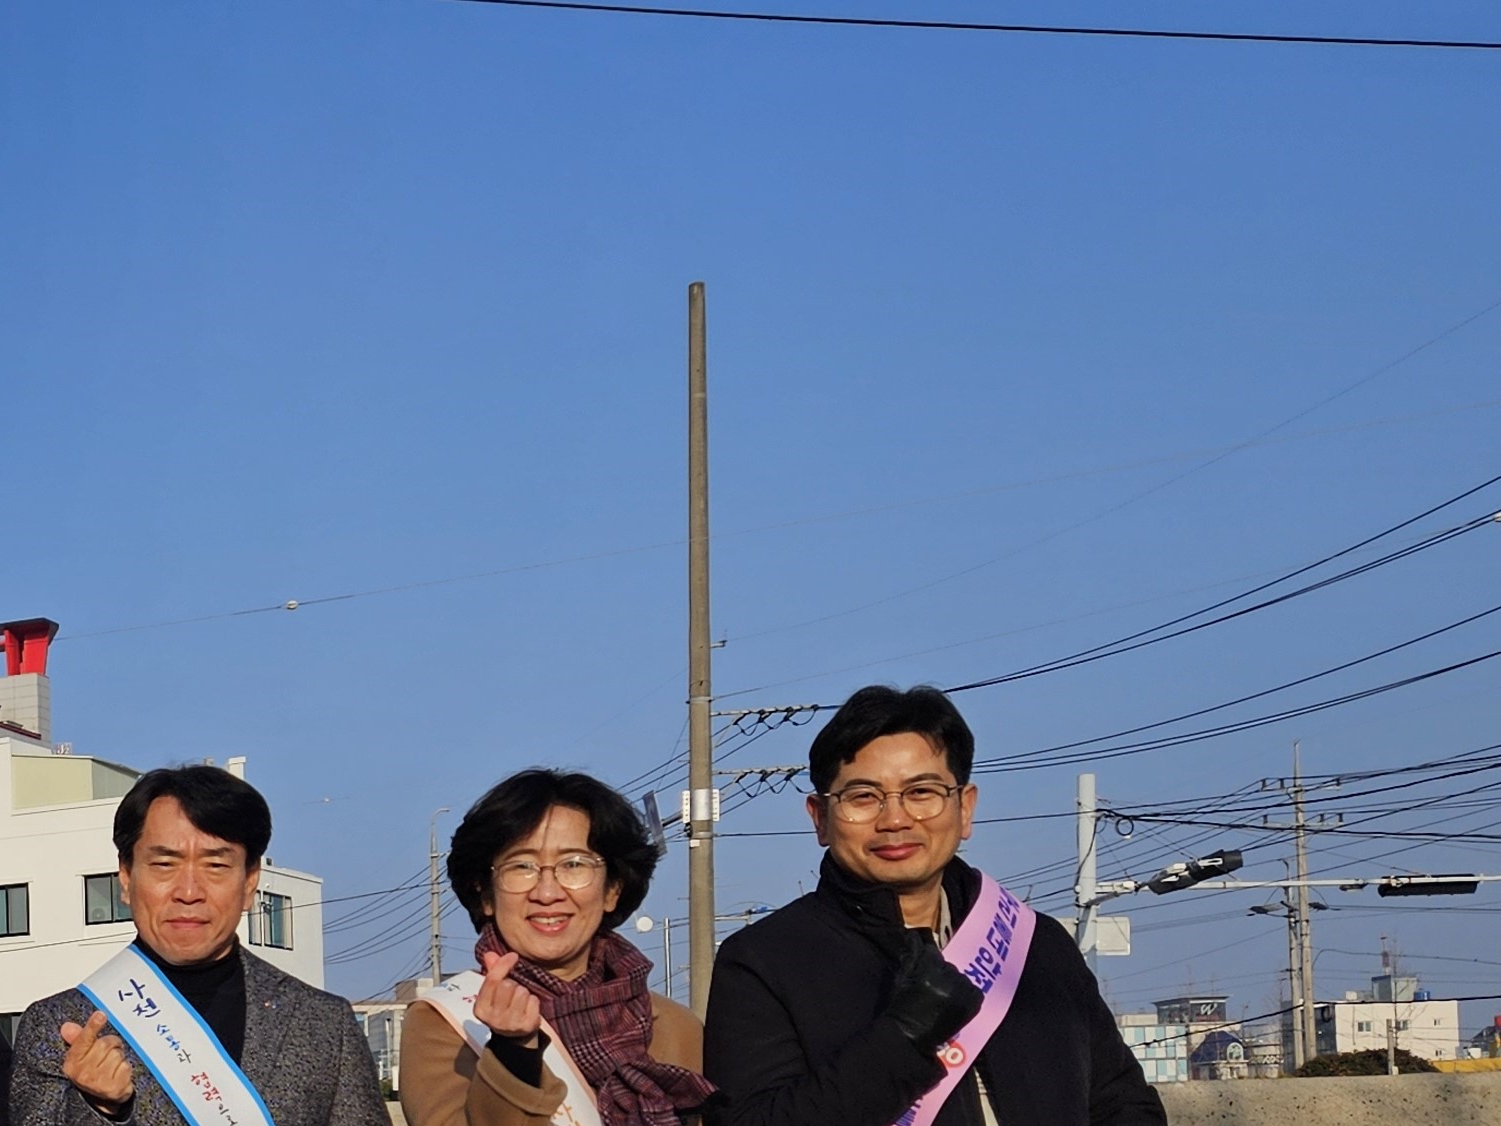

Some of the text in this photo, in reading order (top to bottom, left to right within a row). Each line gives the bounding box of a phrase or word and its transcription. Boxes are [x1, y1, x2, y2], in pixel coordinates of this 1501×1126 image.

[117, 978, 161, 1019] 사천
[156, 1023, 192, 1064] 소통과
[190, 1071, 239, 1126] 협력으로
